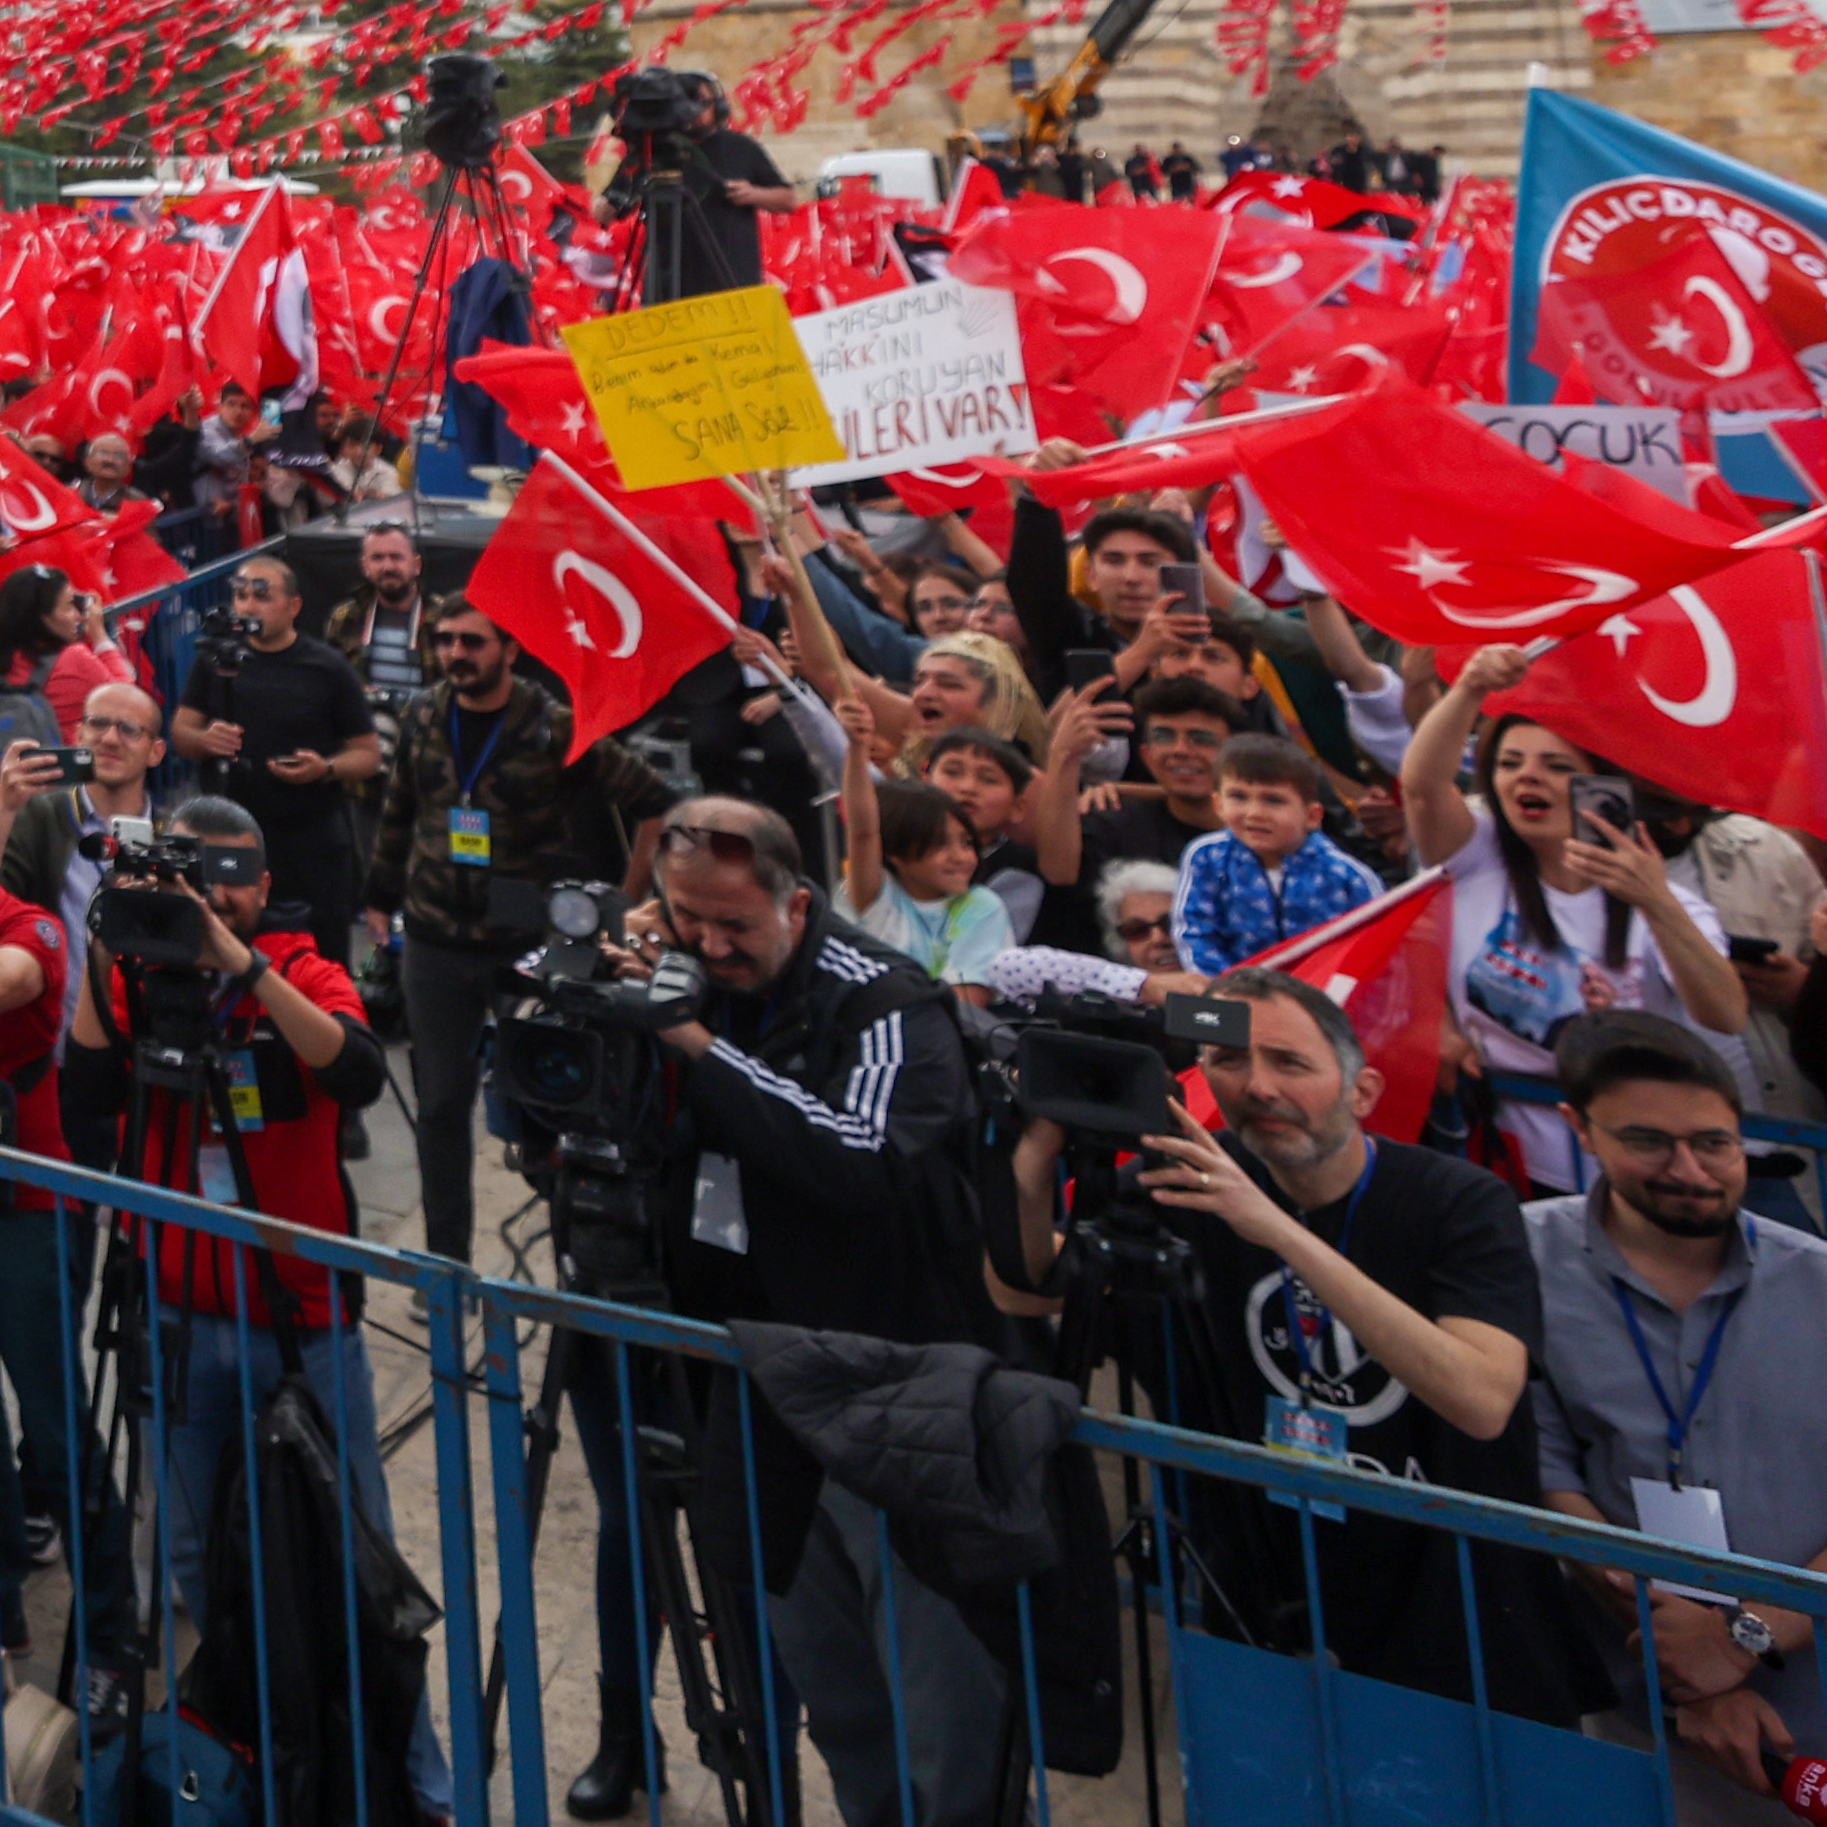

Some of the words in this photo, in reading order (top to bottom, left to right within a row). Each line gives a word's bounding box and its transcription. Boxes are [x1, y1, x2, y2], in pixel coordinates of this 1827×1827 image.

[607, 303, 719, 351] DEDEM
[826, 285, 962, 340] MASUMUN
[865, 349, 1006, 405] KORUYAN
[673, 411, 744, 461] SANA
[936, 383, 1027, 440] VAR!
[1798, 1761, 1827, 1808] anka
